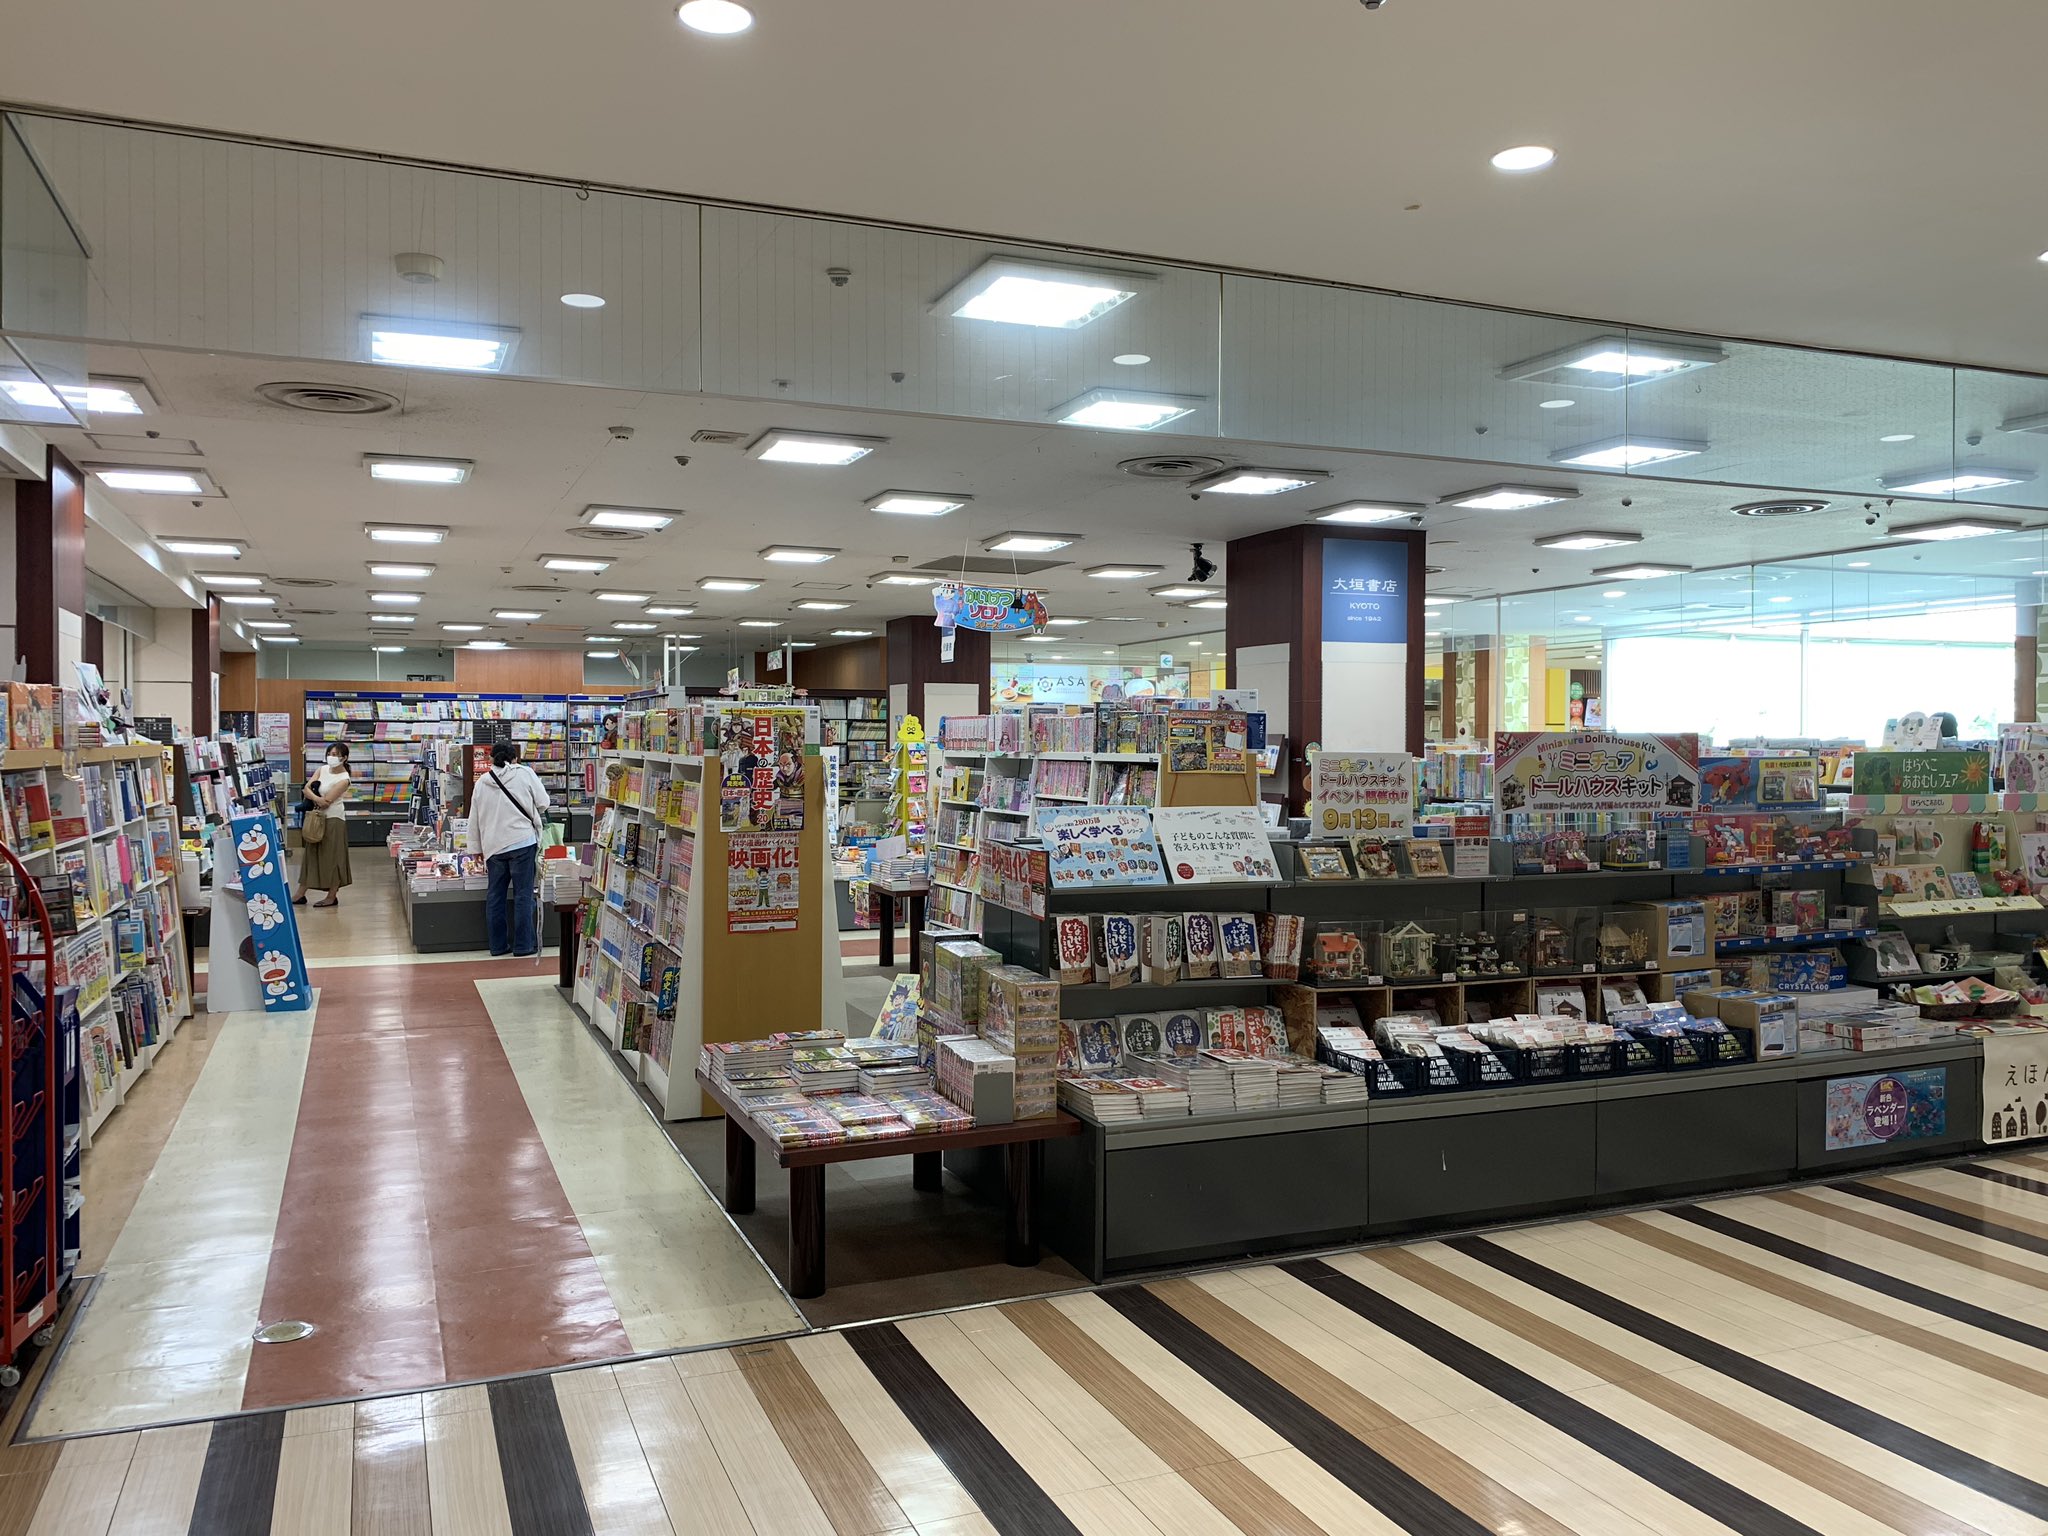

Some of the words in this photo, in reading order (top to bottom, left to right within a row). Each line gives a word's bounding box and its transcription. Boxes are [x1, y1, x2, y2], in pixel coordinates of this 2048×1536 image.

[1332, 577, 1398, 593] 大垣書店
[965, 588, 1014, 606] かいけつ
[1349, 602, 1380, 610] KYOTO
[1057, 676, 1086, 687] ASA
[1537, 737, 1584, 753] Miniature
[1585, 734, 1610, 744] Doll's
[1611, 736, 1641, 749] house
[1641, 743, 1657, 754] Kit
[752, 716, 774, 810] 日本の歴史
[1320, 759, 1368, 773] ミニチュア
[1559, 750, 1635, 772] ミニチュア
[1902, 758, 1938, 772] はらぺこ
[1319, 774, 1405, 788] ドールハウスキット
[1530, 775, 1663, 798] ドールハウスキット
[1902, 773, 1959, 789] あおむしフェア
[1318, 789, 1409, 805] イベント開催中!!
[1056, 824, 1124, 841] 楽しく学べる
[1173, 831, 1256, 841] 子どものこんな質問に
[1173, 842, 1241, 852] 答えられますか?
[728, 847, 800, 870] 映画化!
[2005, 1064, 2048, 1087] えほ
[1880, 1094, 1892, 1103] 新色
[1867, 1102, 1905, 1116] ラベンダー
[1874, 1115, 1898, 1127] 登場!!
